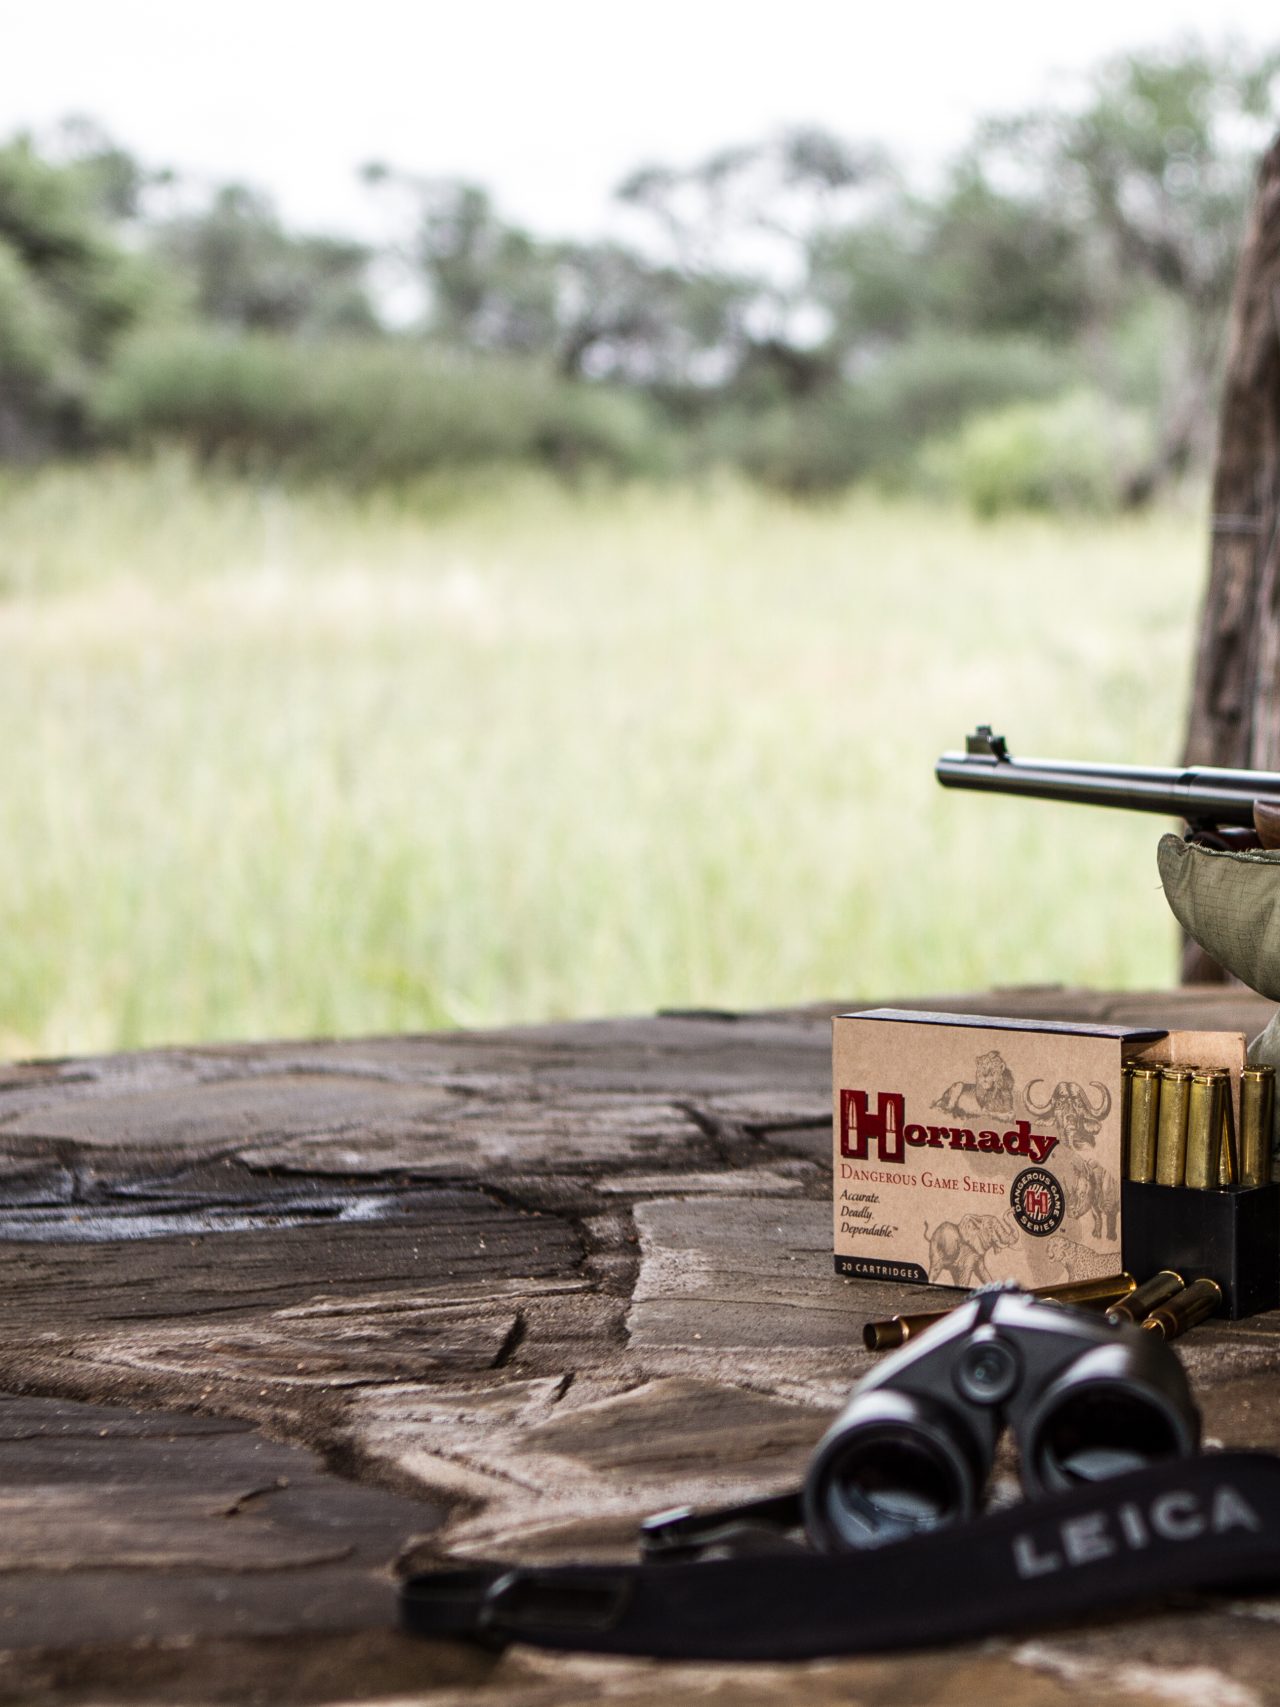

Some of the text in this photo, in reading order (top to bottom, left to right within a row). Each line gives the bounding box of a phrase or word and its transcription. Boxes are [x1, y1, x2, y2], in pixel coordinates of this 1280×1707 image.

[840, 1089, 1059, 1164] Hornady
[839, 1189, 881, 1204] Accurate.
[840, 1206, 875, 1223] Deadly.
[1014, 1172, 1061, 1232] DANGEROUS GAME SERIES
[841, 1262, 919, 1279] 20 CARTRIDGES
[1013, 1485, 1260, 1579] LEICA
